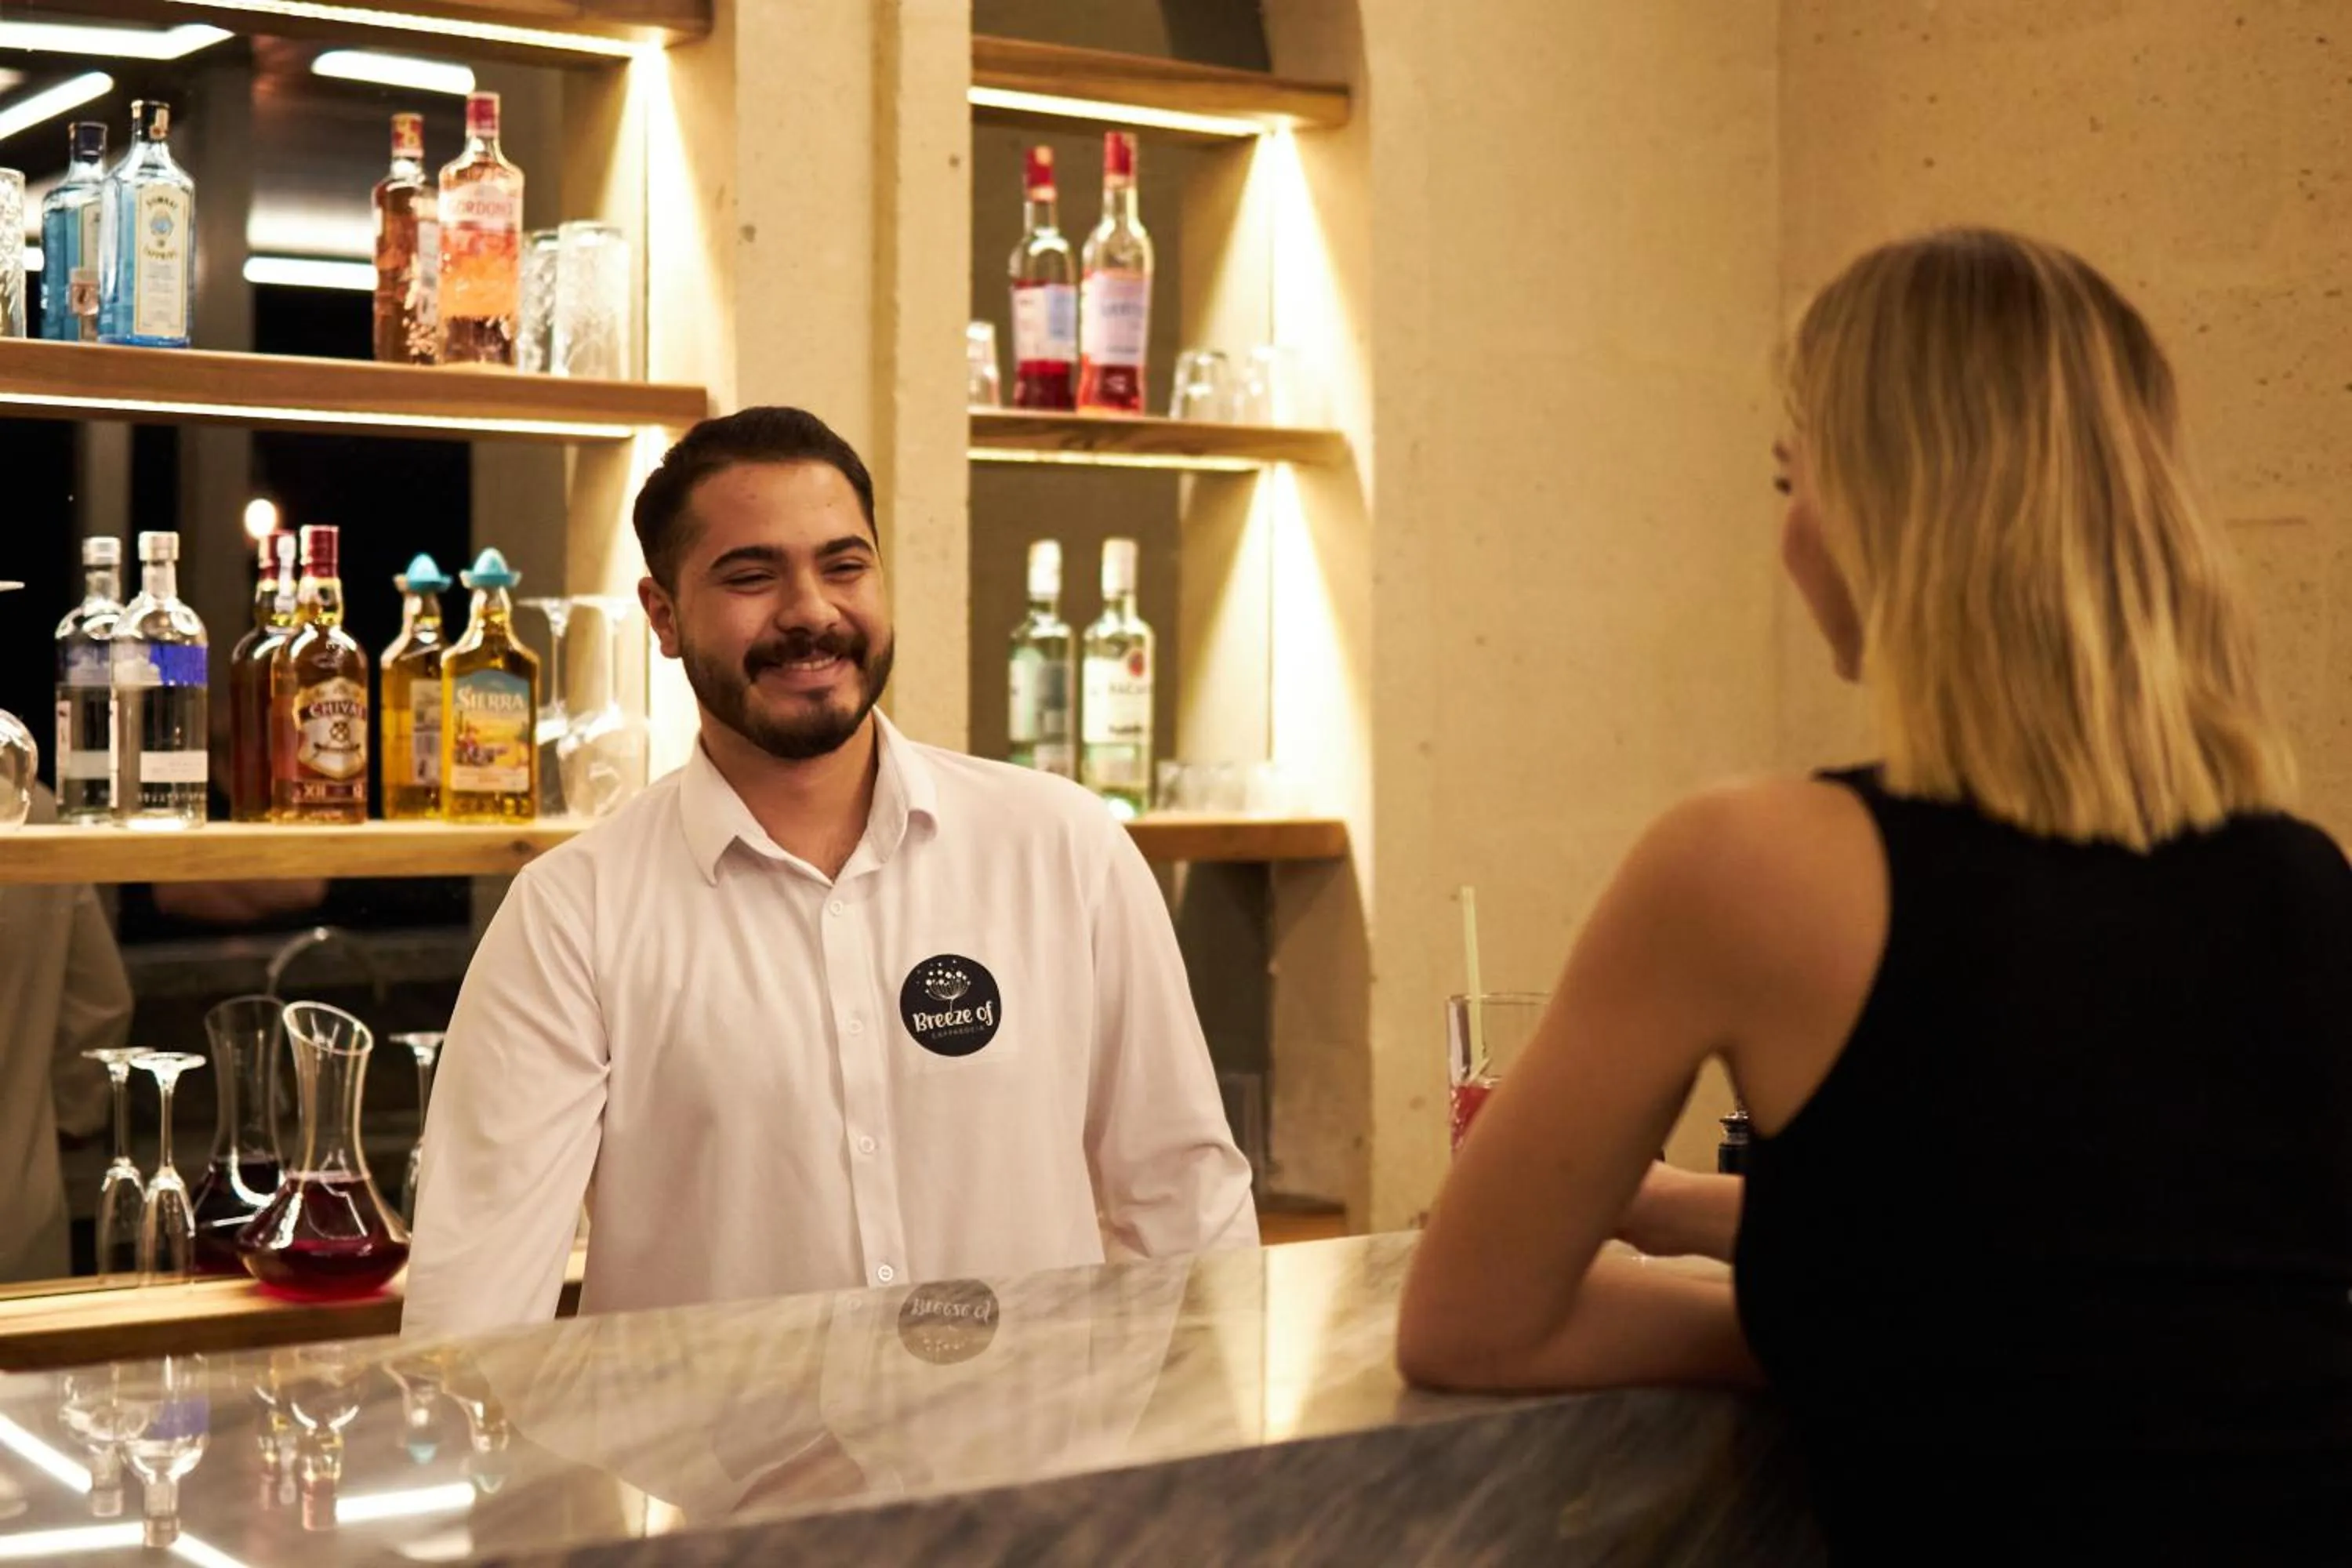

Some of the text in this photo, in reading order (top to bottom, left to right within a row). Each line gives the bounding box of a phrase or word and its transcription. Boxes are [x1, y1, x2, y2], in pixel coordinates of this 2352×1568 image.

[457, 684, 525, 711] SIERRA
[912, 1000, 993, 1033] Breeze of
